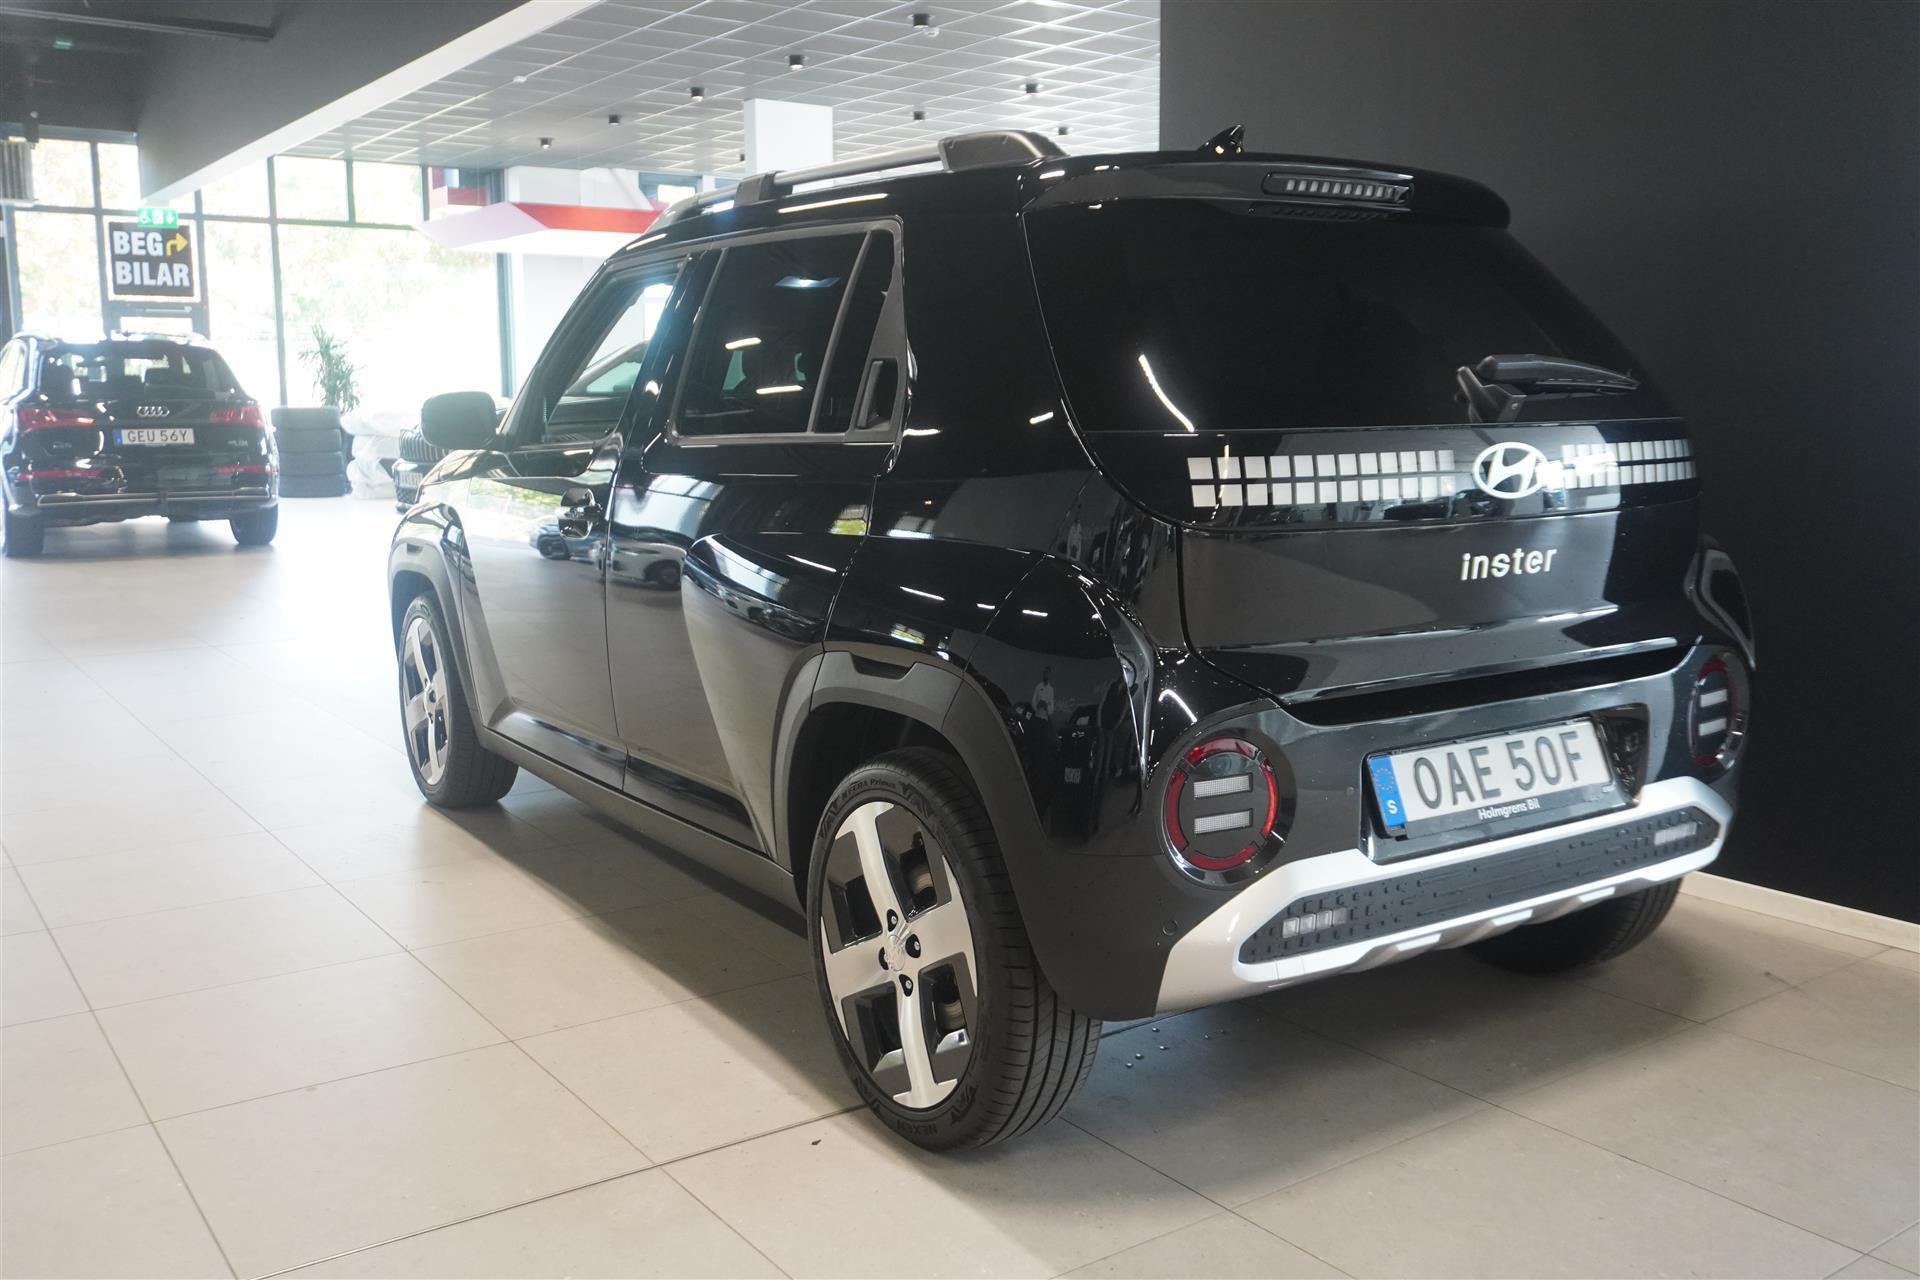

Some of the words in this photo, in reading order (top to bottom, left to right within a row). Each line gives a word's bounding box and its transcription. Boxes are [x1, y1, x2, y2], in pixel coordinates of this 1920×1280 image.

[112, 230, 164, 257] BEG
[115, 260, 190, 287] BILAR
[160, 430, 188, 442] 56Y
[1461, 548, 1557, 581] inster
[1413, 745, 1501, 810] OAE
[1505, 731, 1582, 791] 50F
[1387, 799, 1399, 815] S
[1479, 804, 1528, 820] Holmgrens
[1528, 798, 1541, 810] Bil
